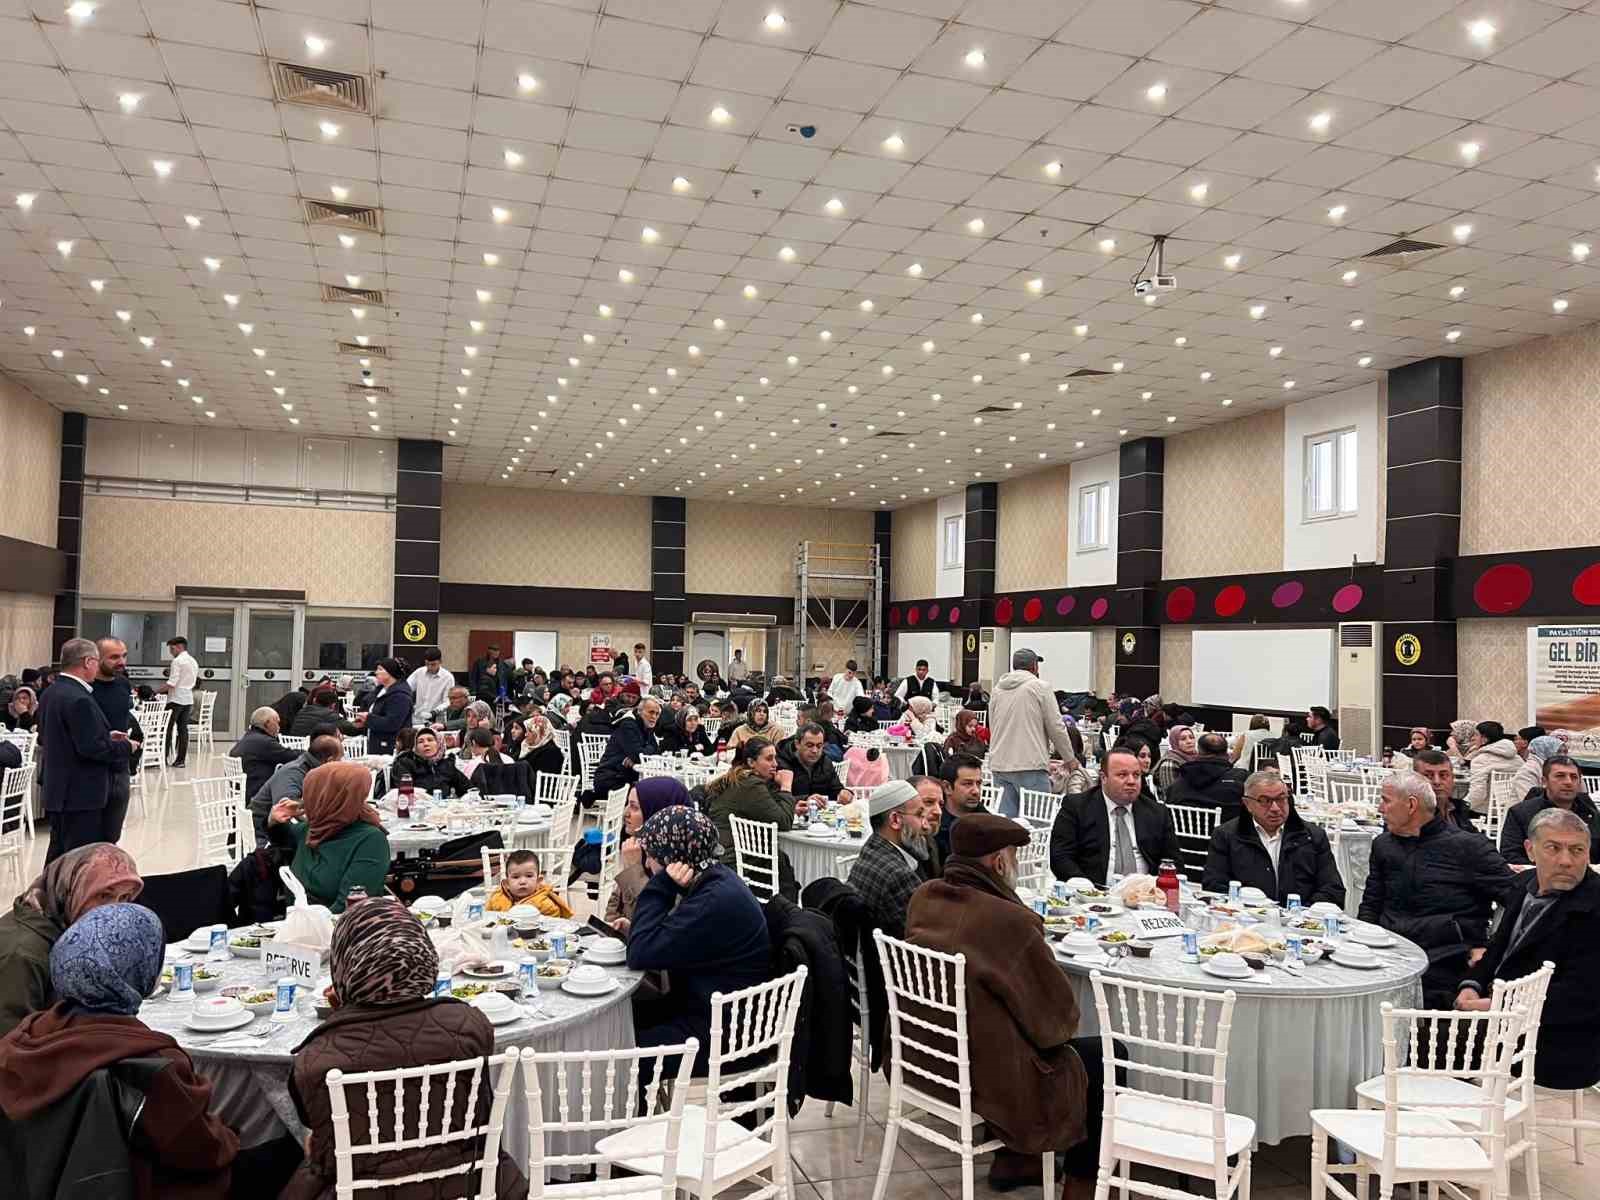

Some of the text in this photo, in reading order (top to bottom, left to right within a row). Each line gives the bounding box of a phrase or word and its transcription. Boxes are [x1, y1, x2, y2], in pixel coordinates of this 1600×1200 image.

[1549, 638, 1598, 662] GEL BİR
[1140, 917, 1184, 930] REZERVE
[266, 952, 311, 978] RRVE
